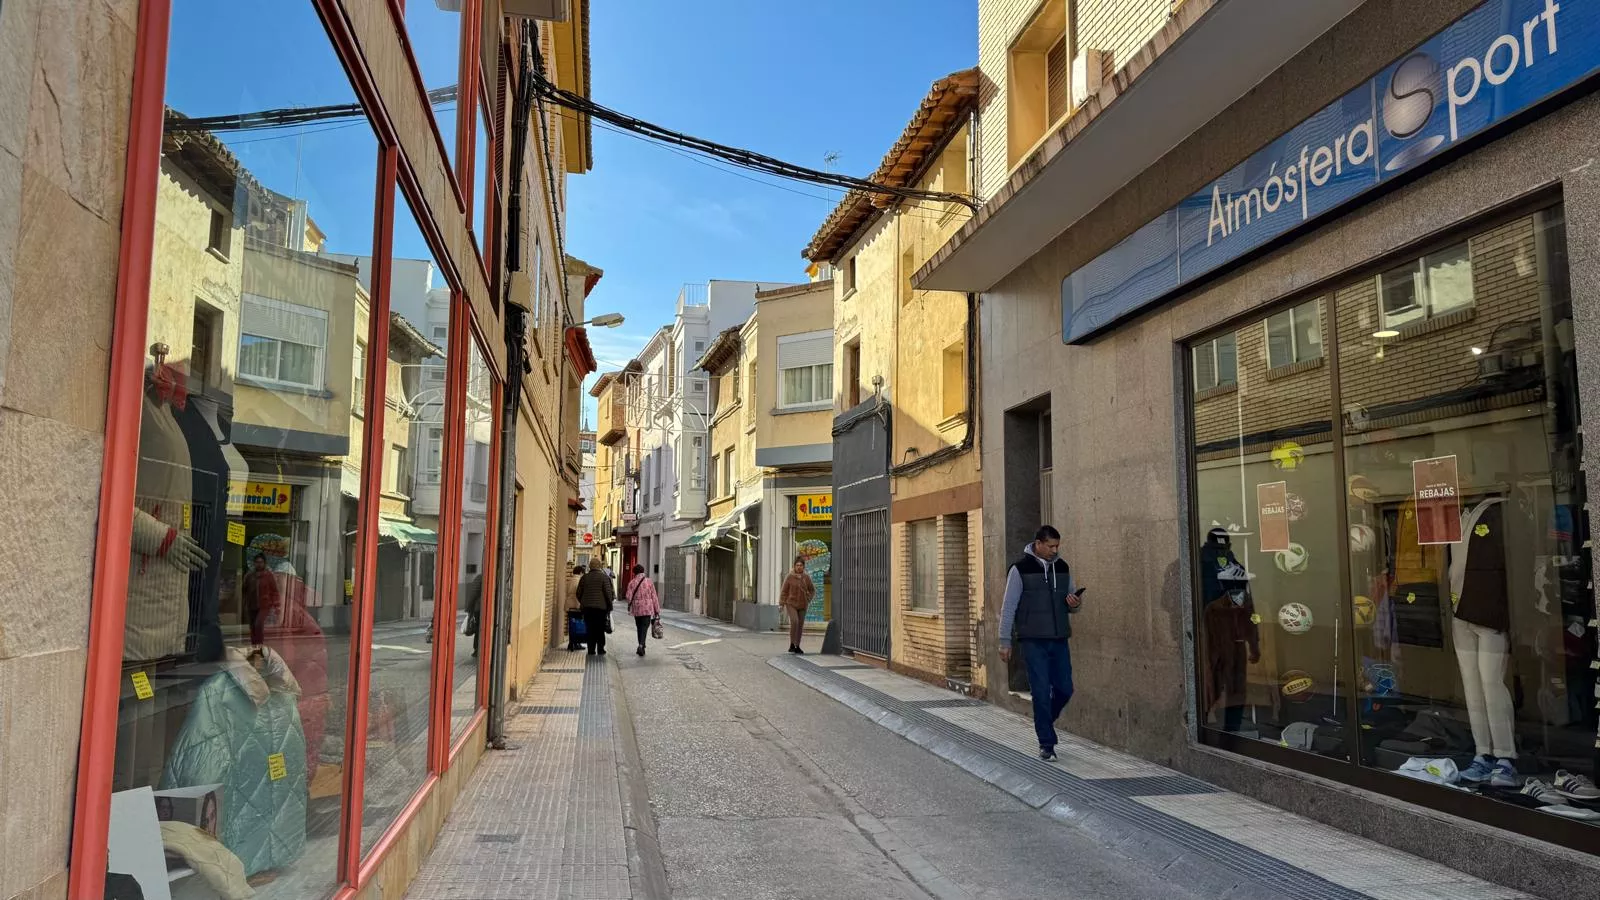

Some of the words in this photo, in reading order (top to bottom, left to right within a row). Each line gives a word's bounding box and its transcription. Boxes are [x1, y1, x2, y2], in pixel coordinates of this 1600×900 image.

[1207, 118, 1374, 247] Atmósfera
[1386, 0, 1560, 142] Sport
[1419, 487, 1455, 499] REBAJAS
[1261, 506, 1285, 515] REBAJAS
